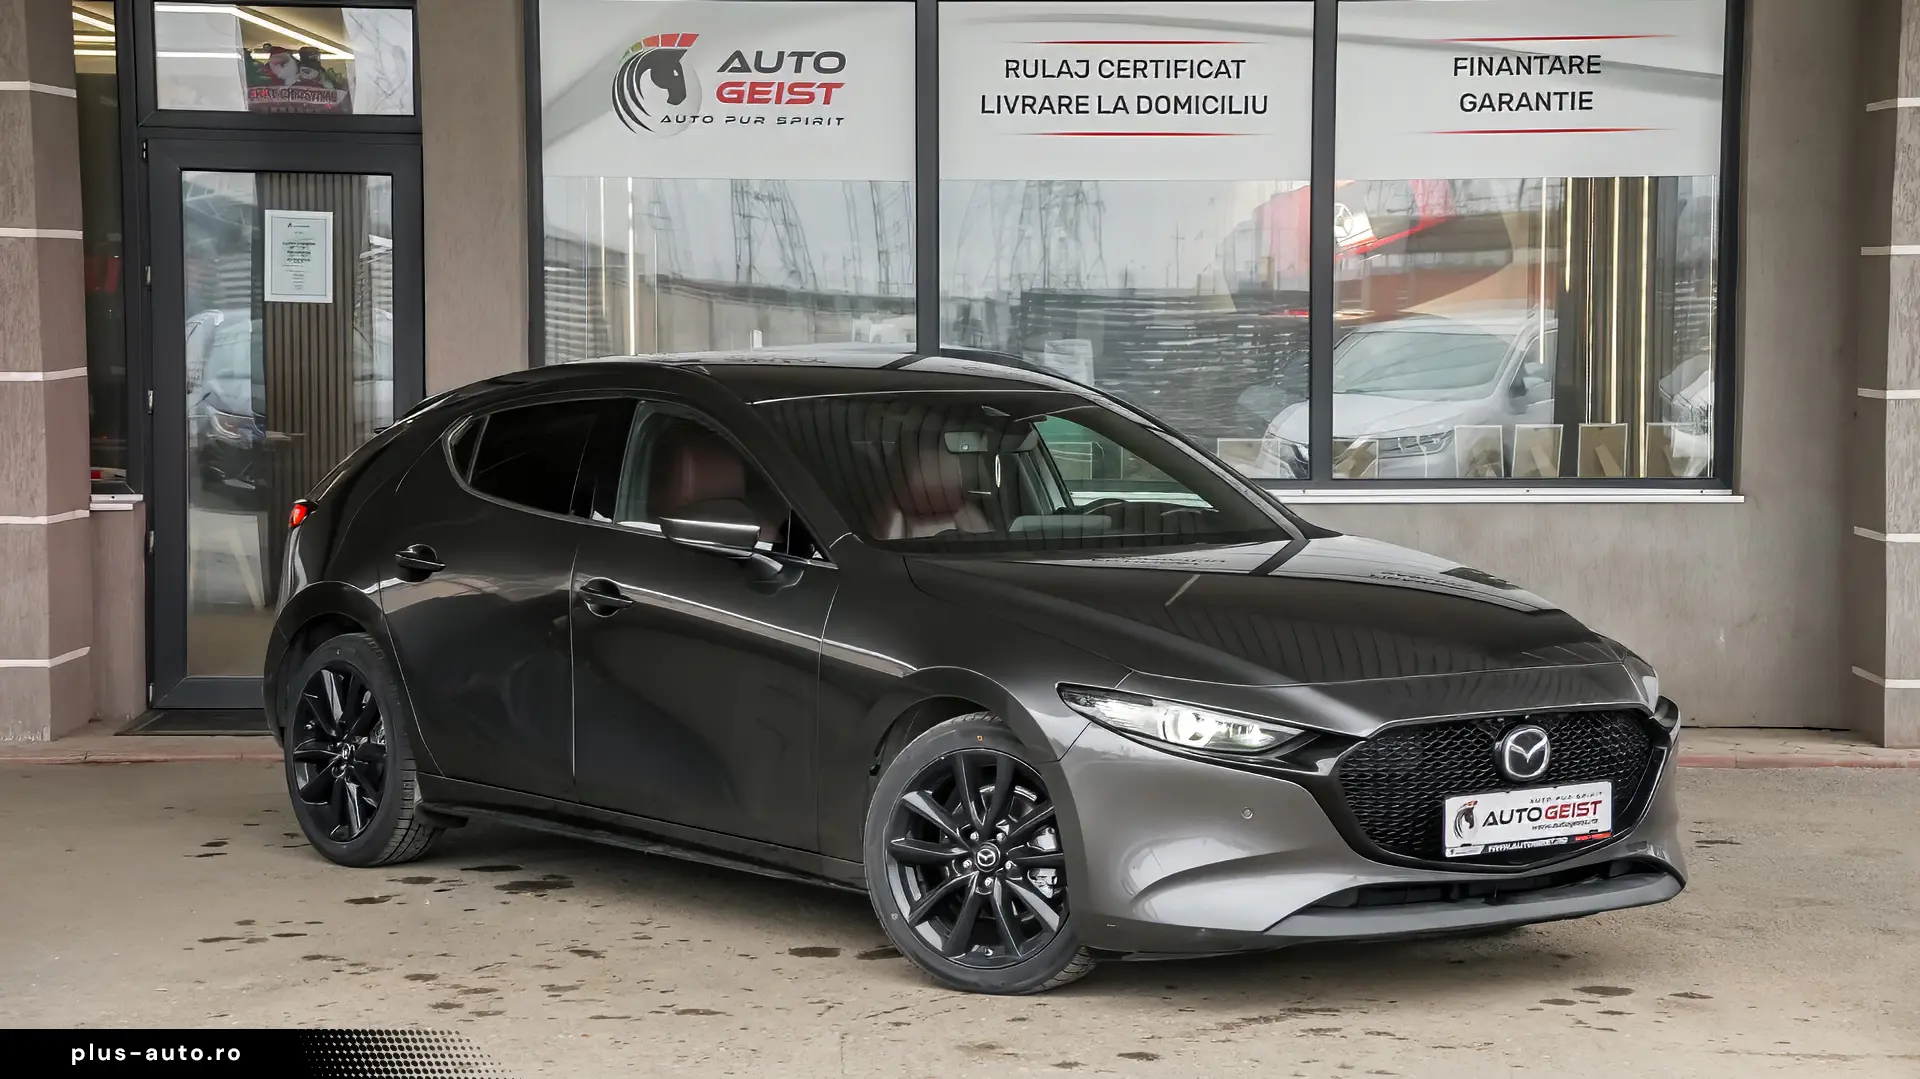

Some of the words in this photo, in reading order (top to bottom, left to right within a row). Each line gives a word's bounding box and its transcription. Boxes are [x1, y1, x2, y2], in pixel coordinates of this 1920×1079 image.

[717, 50, 846, 74] AUTO
[1005, 59, 1090, 79] RULAJ
[1098, 59, 1246, 79] CERTIFICAT
[1453, 55, 1602, 77] FINANTARE
[716, 81, 845, 105] GEIST
[1459, 91, 1594, 113] GARANTIE
[981, 95, 1090, 115] LIVRARE
[1097, 95, 1130, 115] LA
[1136, 95, 1268, 115] DOMICILIU
[660, 114, 714, 124] AUTO
[725, 115, 766, 125] PUR
[776, 116, 845, 126] SPIRIT
